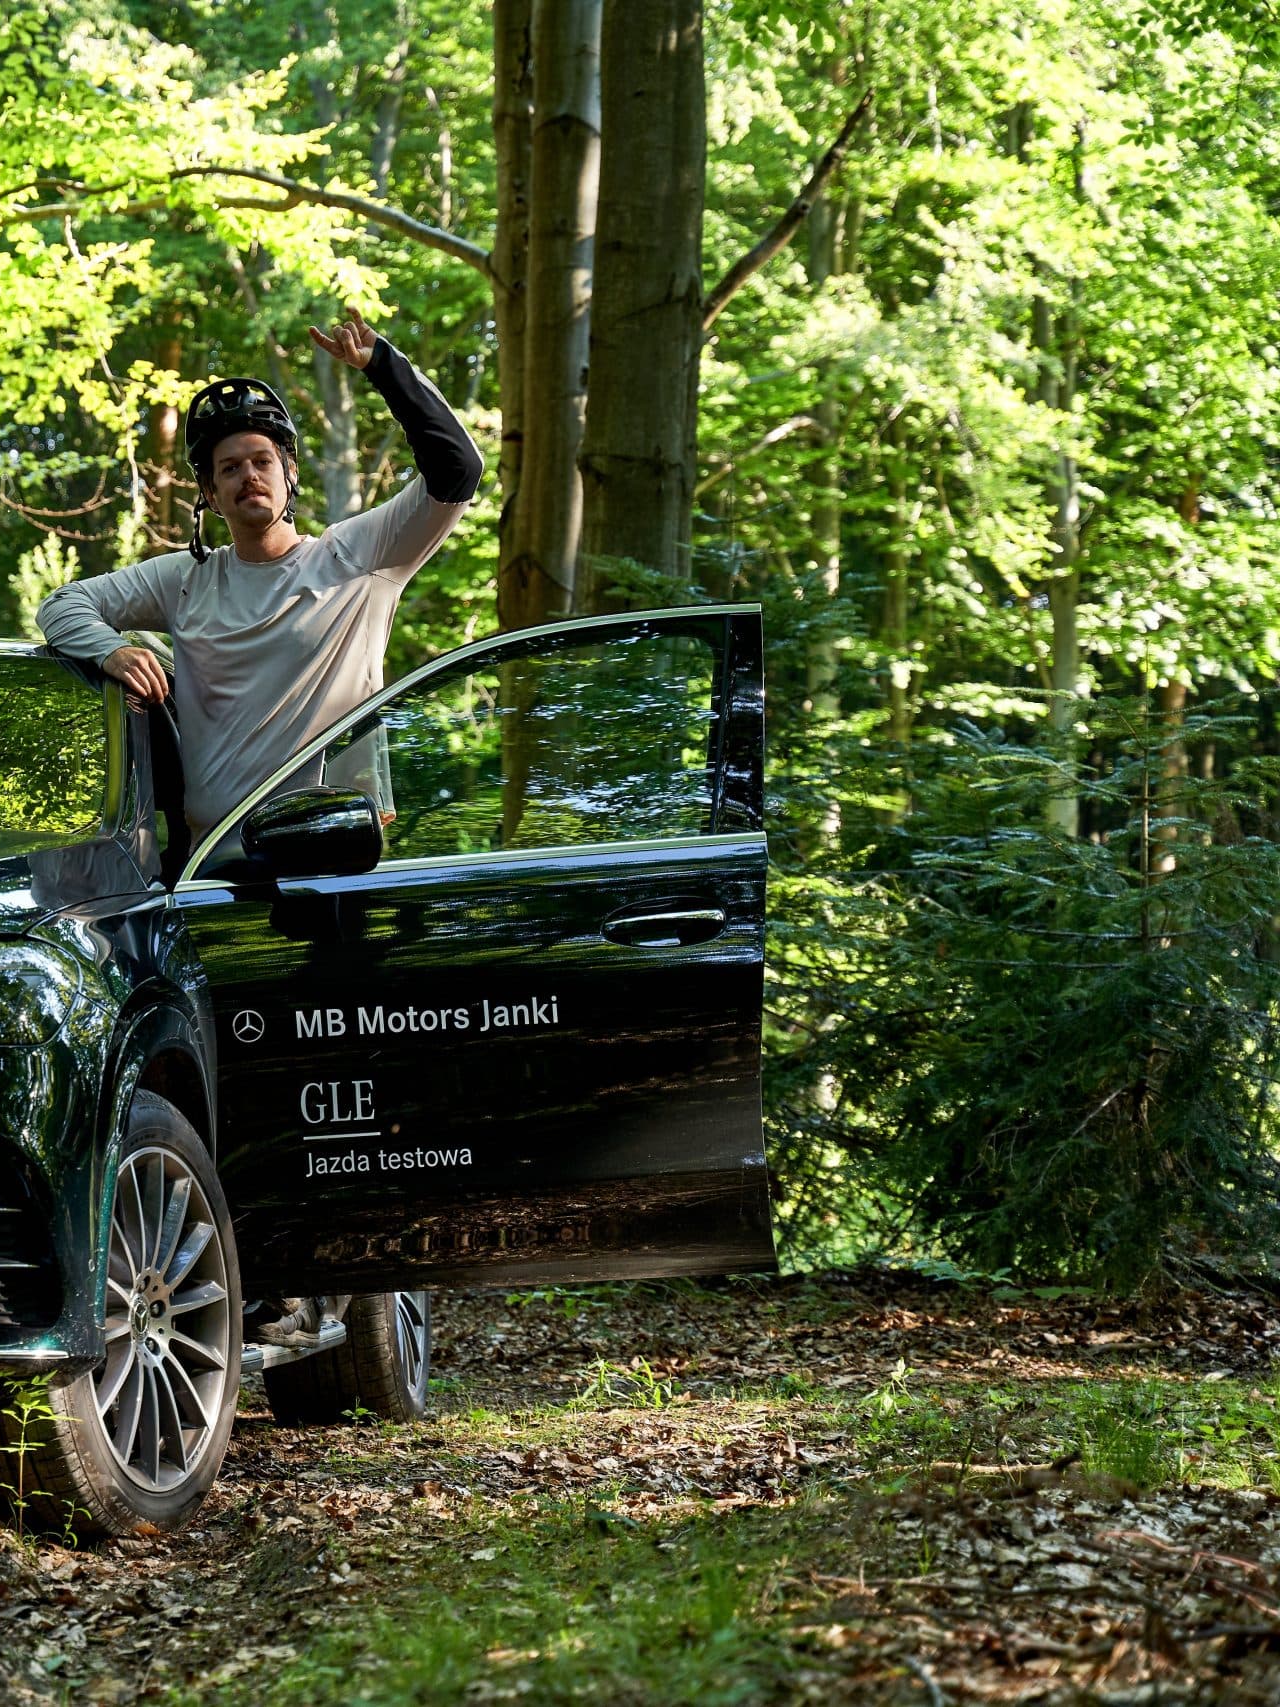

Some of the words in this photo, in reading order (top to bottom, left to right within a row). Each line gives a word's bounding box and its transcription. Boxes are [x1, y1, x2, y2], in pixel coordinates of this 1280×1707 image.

[296, 1008, 346, 1039] MB
[357, 1005, 470, 1035] Motors
[480, 995, 559, 1032] Janki
[300, 1079, 376, 1124] GLE
[305, 1150, 370, 1178] Jazda
[378, 1147, 473, 1170] testowa
